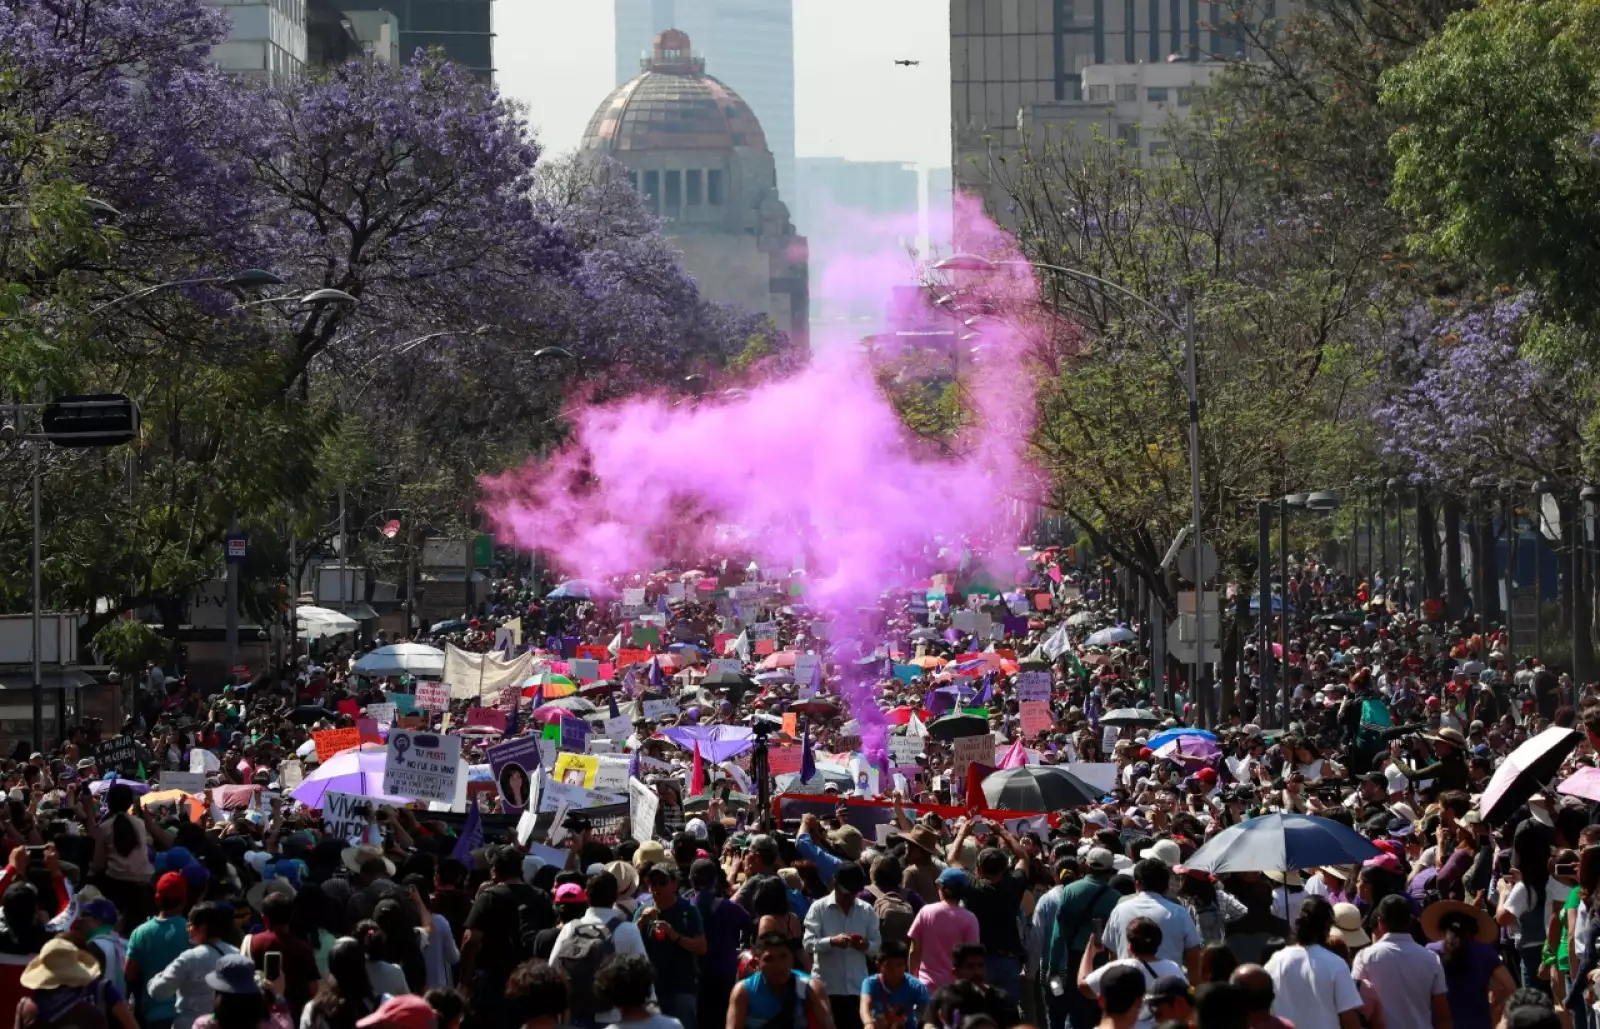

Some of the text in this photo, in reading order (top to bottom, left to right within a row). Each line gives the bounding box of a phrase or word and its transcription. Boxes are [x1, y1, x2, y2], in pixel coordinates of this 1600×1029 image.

[415, 749, 425, 757] TU
[407, 761, 455, 775] NO FUE EN VANO
